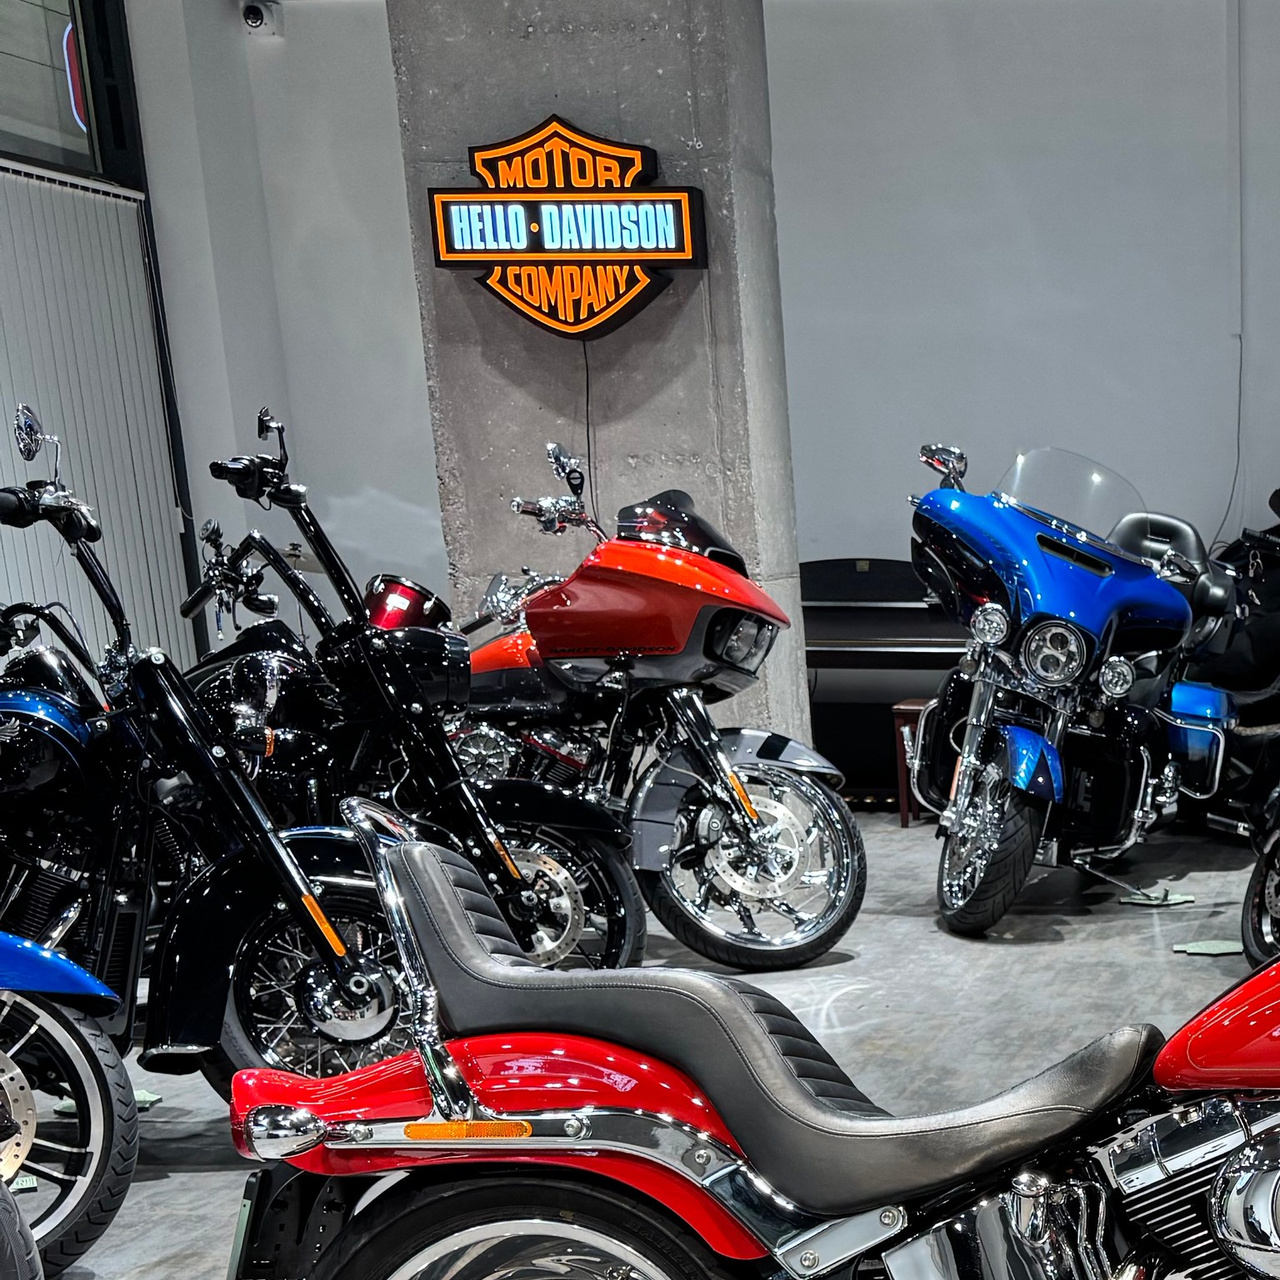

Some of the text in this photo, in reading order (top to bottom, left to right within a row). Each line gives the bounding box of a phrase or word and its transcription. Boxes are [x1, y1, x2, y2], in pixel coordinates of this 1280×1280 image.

[497, 137, 621, 188] MOTOR
[450, 204, 676, 250] HELLO DAVIDSON
[506, 265, 630, 322] COMPANY
